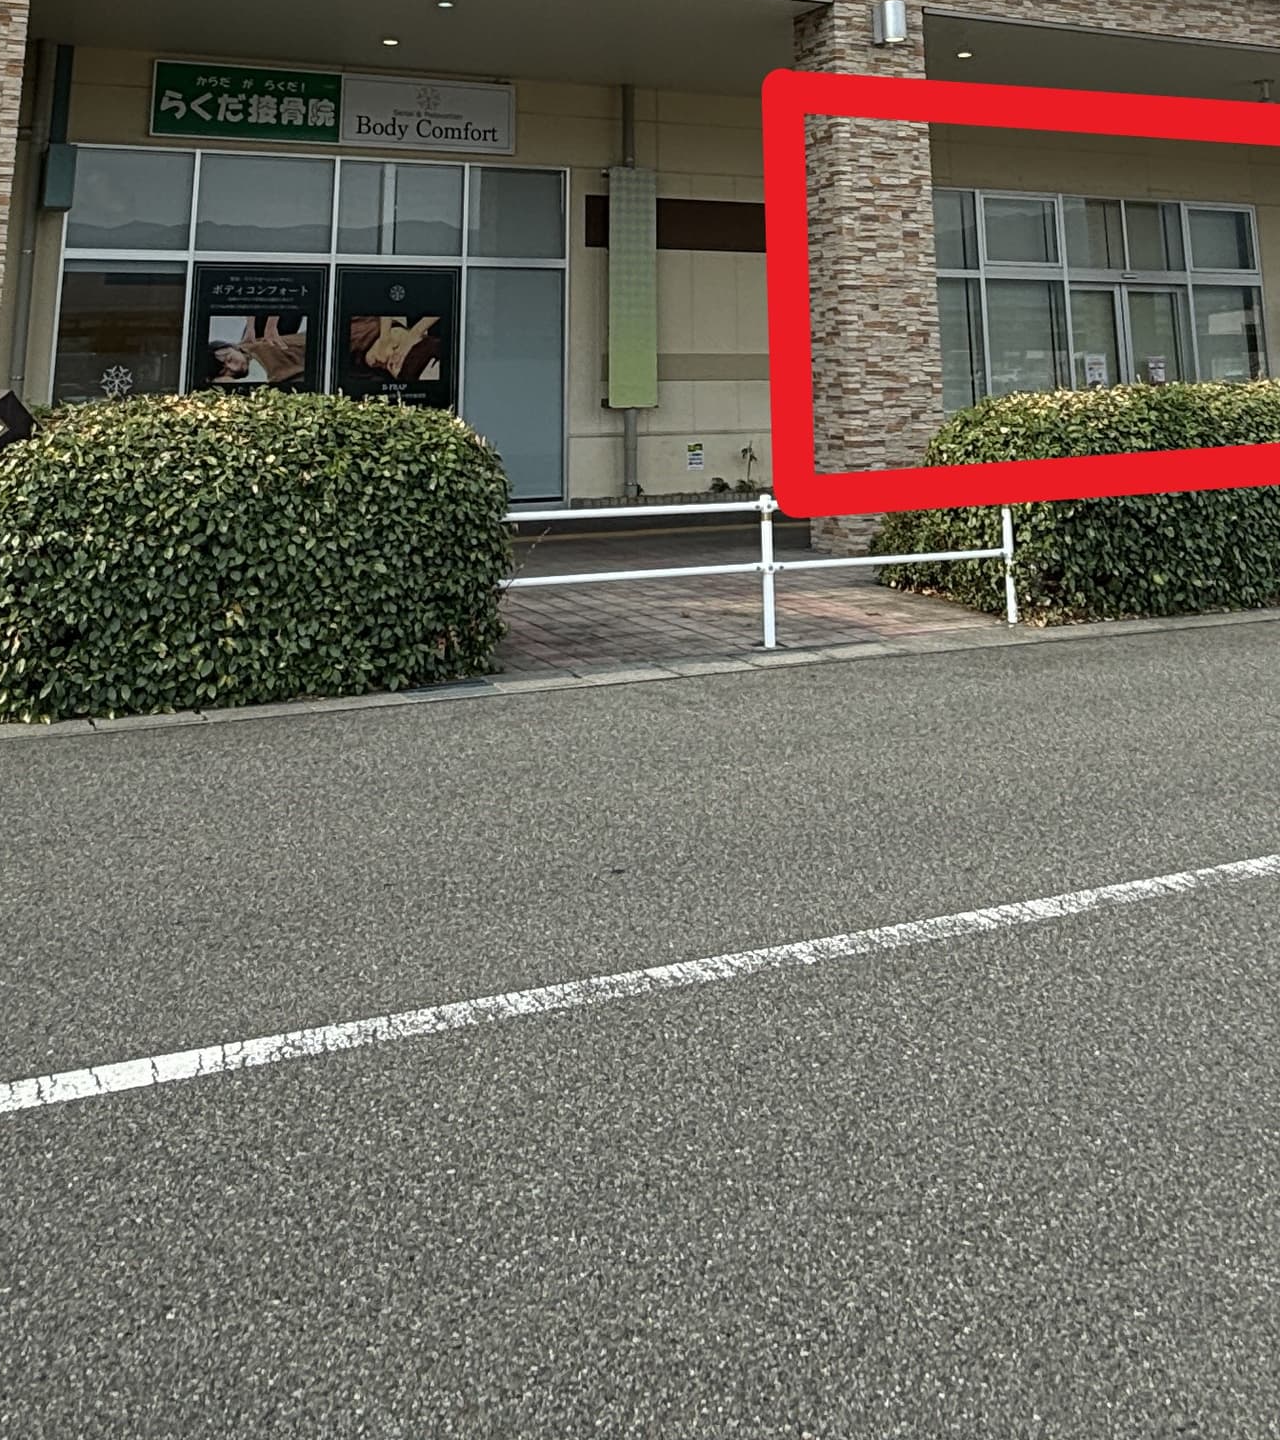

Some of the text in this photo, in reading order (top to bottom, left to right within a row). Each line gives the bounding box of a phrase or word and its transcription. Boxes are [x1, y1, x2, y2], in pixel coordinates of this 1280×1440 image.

[195, 75, 232, 88] からだ
[159, 89, 336, 128] らくだ接骨院
[355, 115, 499, 142] Body Comfort
[211, 285, 309, 297] ボディコンフォート
